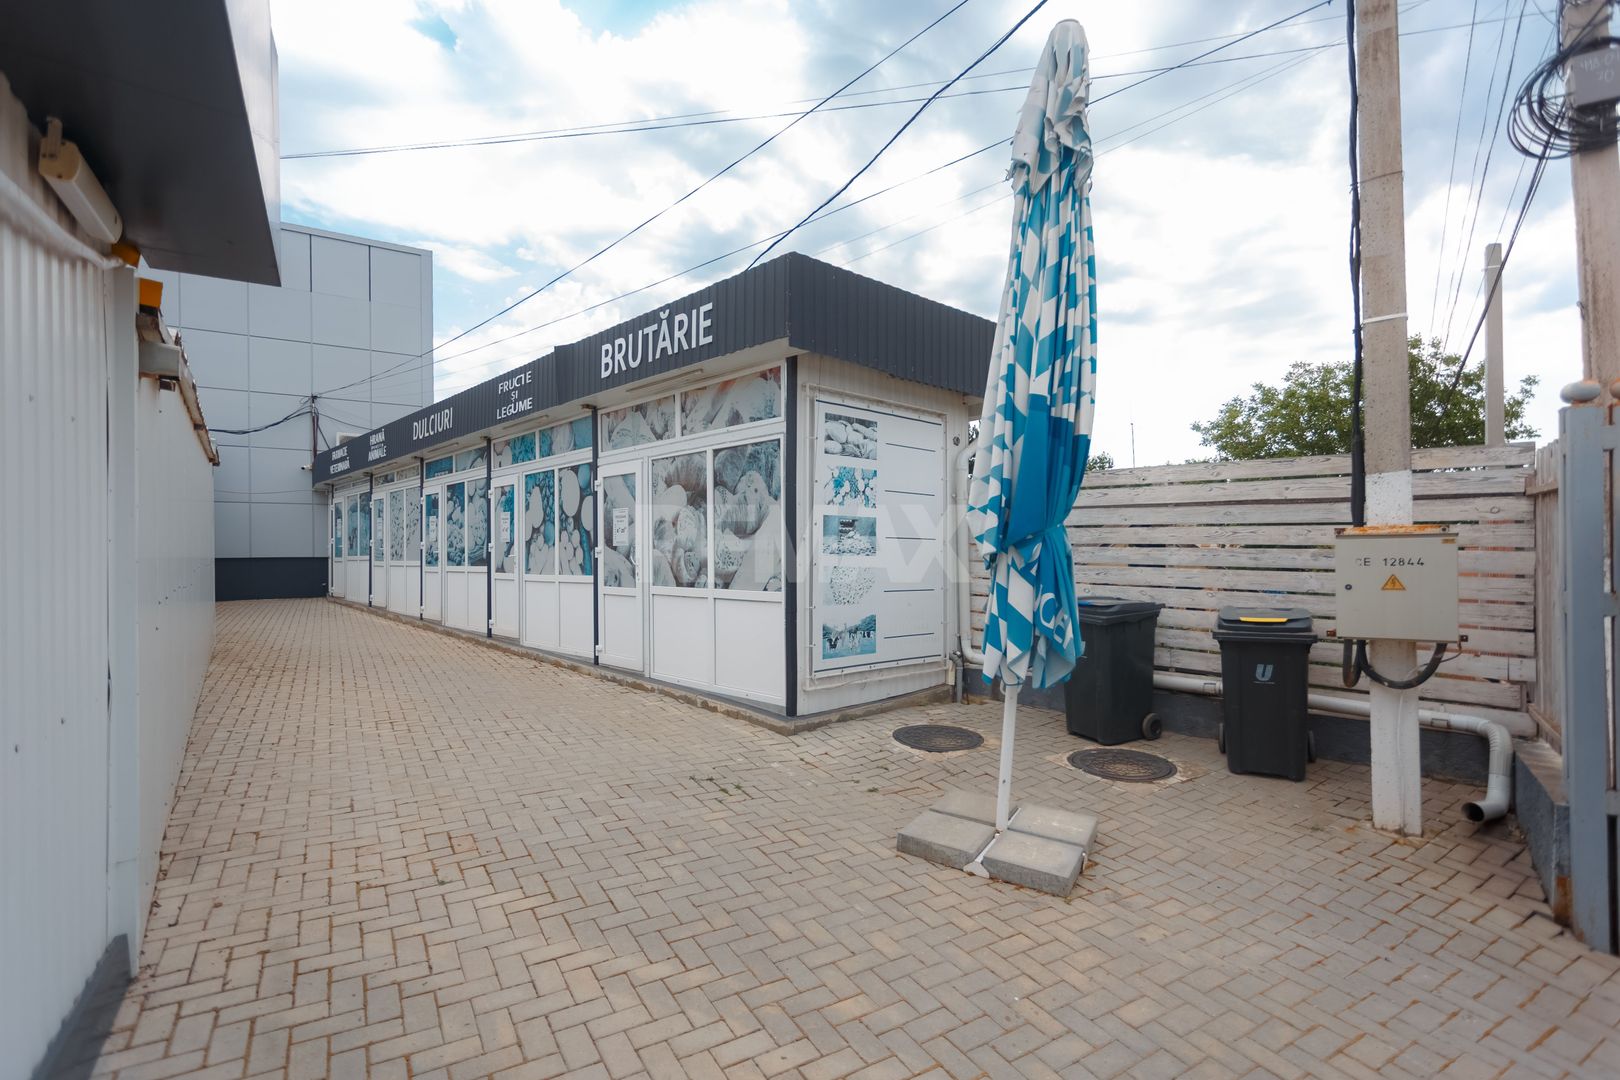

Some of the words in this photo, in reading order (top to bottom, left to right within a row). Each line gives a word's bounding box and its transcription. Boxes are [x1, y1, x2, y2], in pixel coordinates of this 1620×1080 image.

[600, 302, 713, 379] BRUTĂRIE
[498, 370, 532, 395] FRUCTE
[496, 397, 533, 420] LEGUME
[412, 407, 453, 441] DULCIURI
[1382, 557, 1425, 567] 12844
